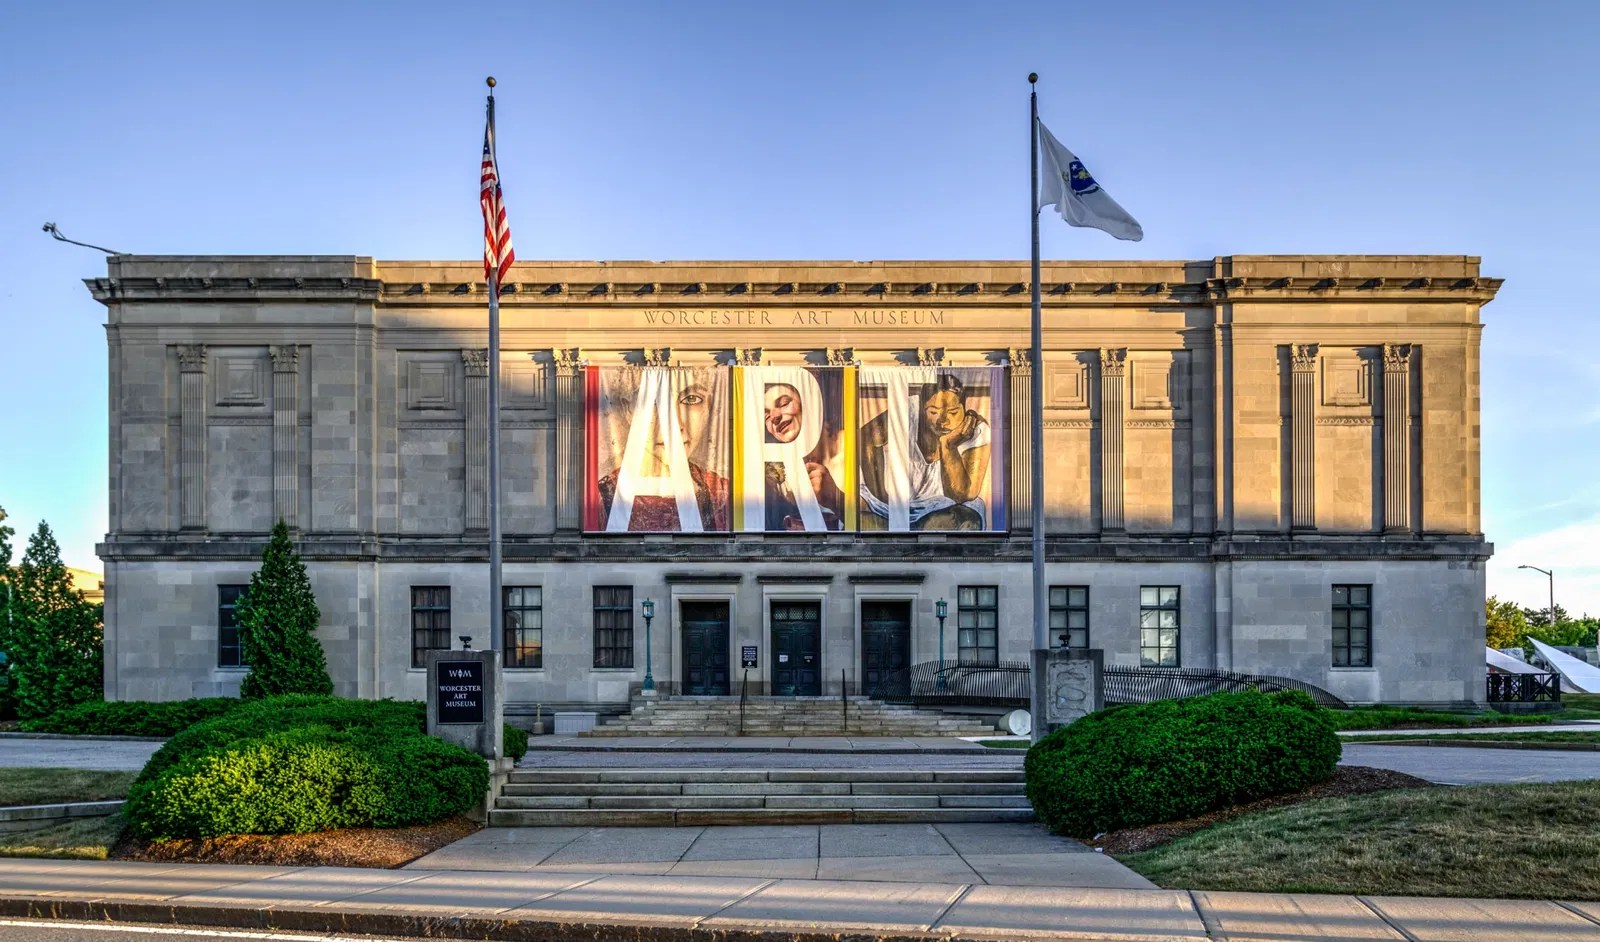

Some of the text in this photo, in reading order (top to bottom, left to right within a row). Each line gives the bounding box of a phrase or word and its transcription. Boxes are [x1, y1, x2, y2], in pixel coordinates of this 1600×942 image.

[643, 310, 945, 326] WORCESTER ART MUSEUM
[606, 366, 937, 532] ART
